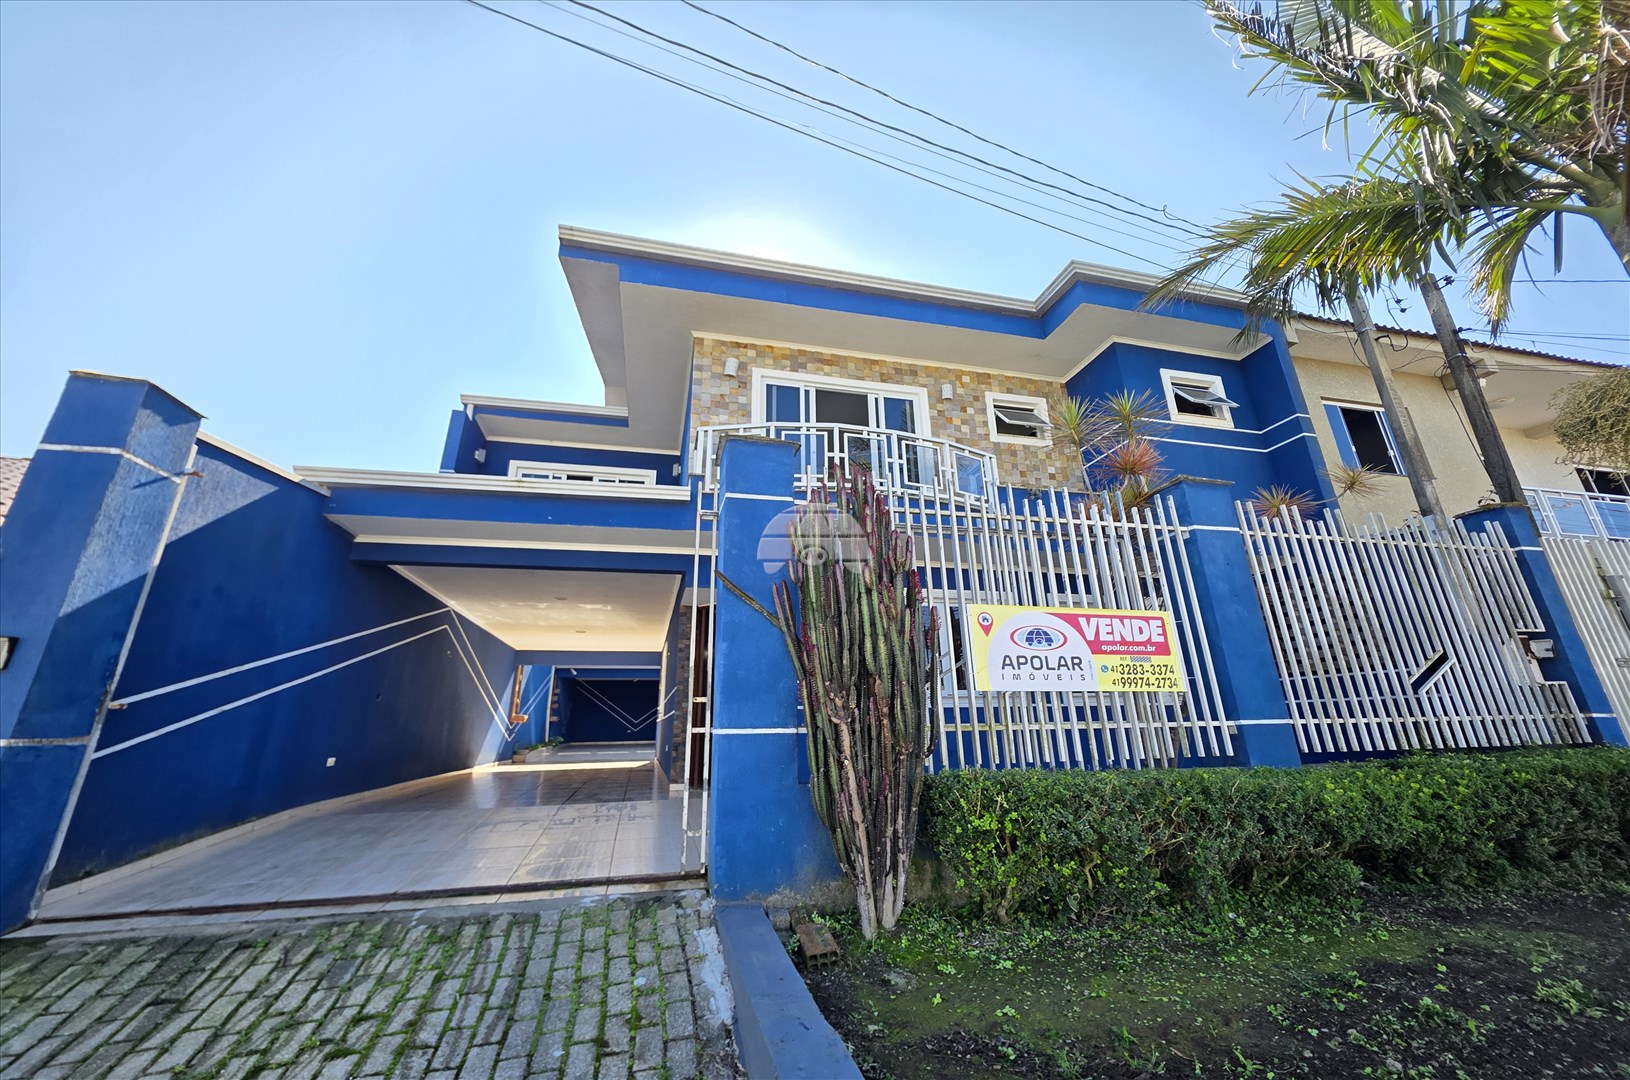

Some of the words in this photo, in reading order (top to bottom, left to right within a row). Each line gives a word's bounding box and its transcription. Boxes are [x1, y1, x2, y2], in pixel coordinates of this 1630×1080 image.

[1078, 617, 1165, 642] VENDE
[1101, 644, 1156, 652] apolar.com.br
[1001, 654, 1084, 671] APOLAR
[1002, 672, 1086, 681] IMÓVEIS
